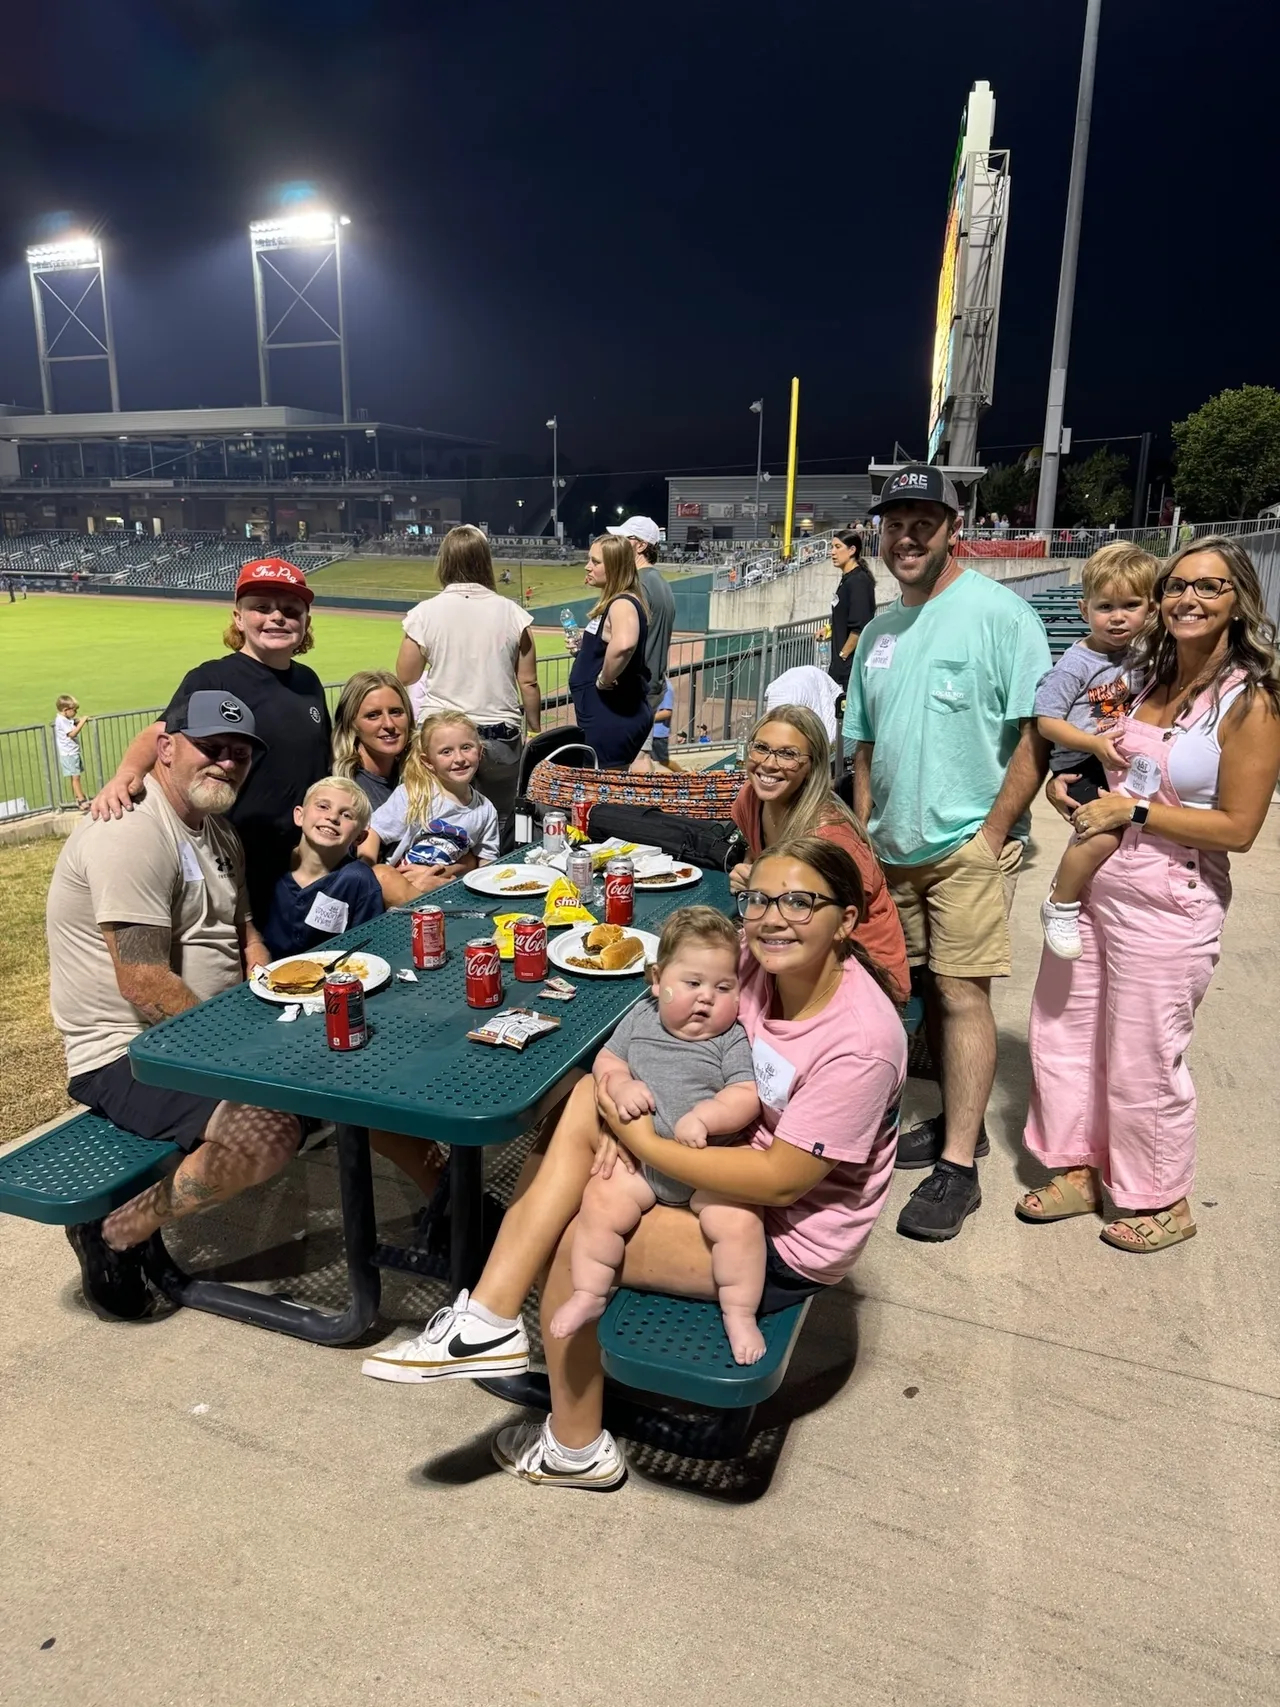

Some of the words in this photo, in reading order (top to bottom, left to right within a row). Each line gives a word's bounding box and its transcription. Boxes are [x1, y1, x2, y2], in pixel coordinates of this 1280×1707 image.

[891, 473, 928, 490] CORE
[709, 541, 728, 551] PAPA
[251, 564, 276, 578] The
[276, 566, 298, 584] Pig
